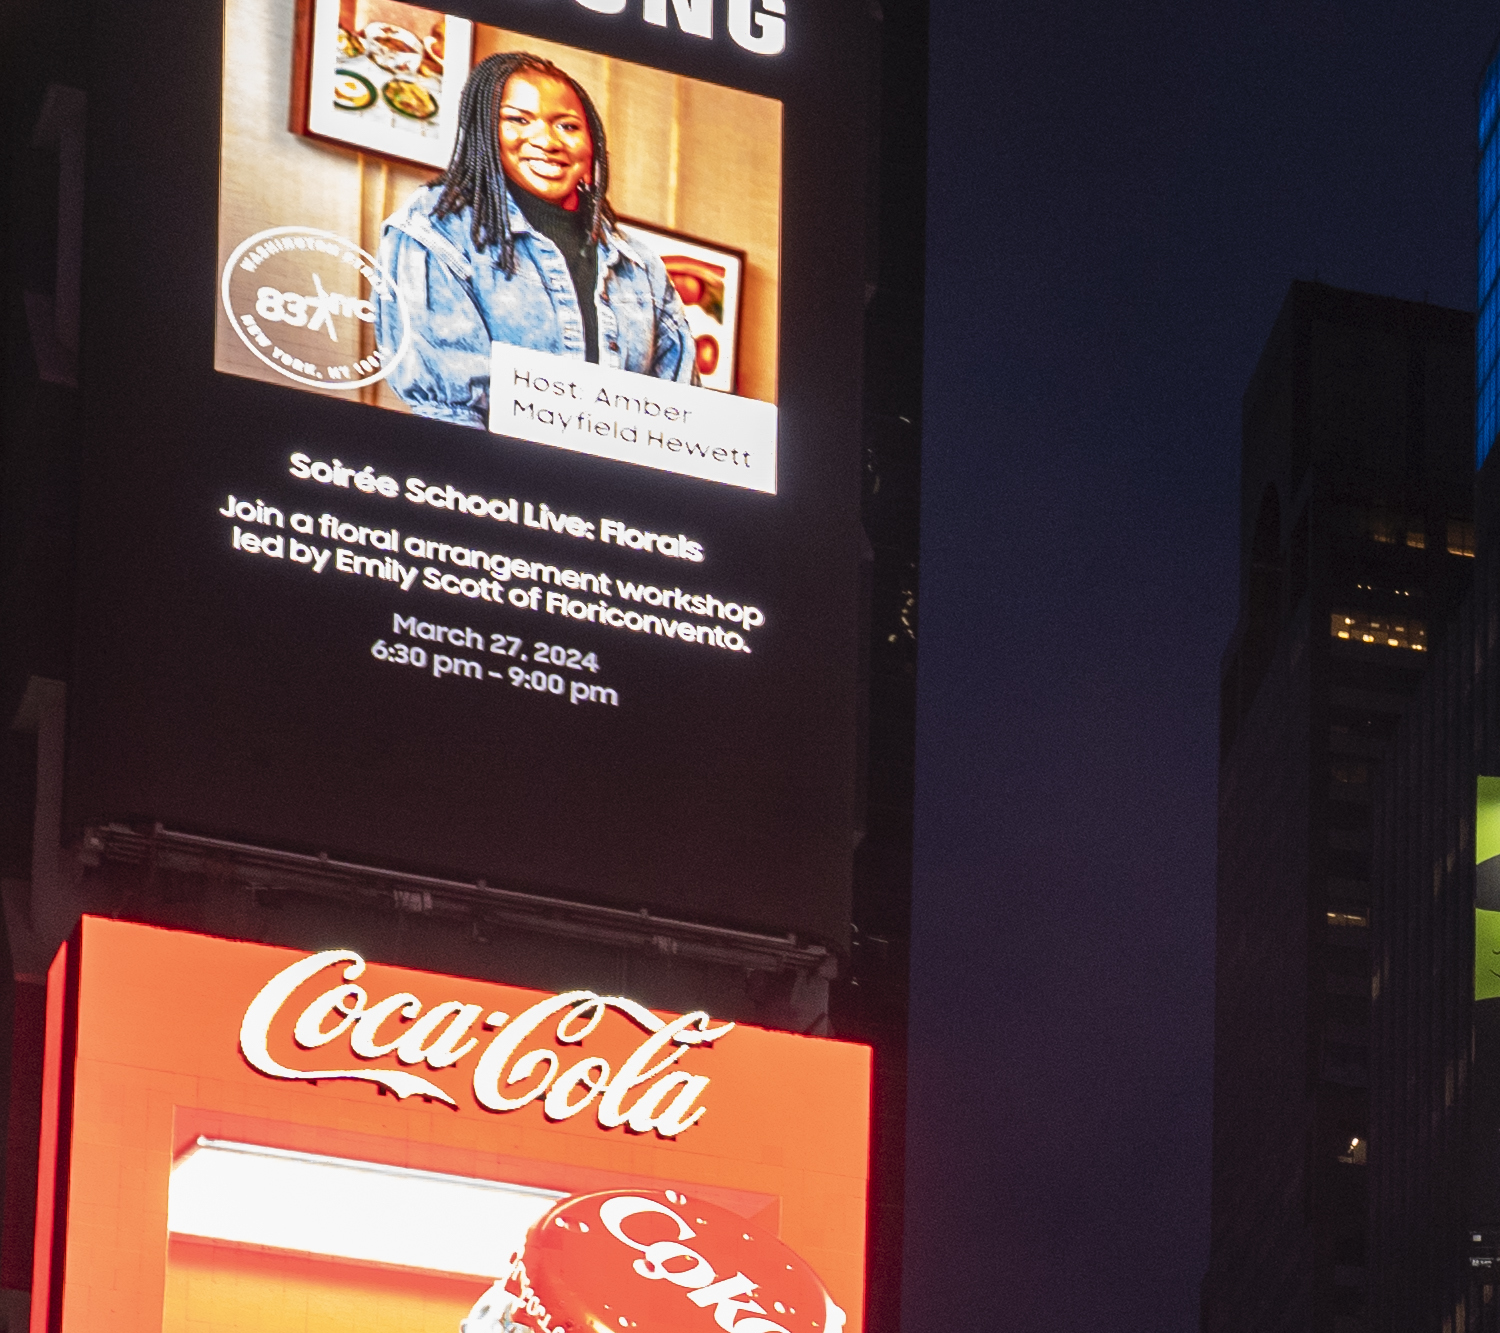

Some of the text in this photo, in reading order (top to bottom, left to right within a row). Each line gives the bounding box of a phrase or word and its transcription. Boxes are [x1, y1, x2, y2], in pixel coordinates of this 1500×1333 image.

[512, 367, 693, 425] Host: Amber
[512, 399, 753, 470] Mayfield Hewett
[289, 452, 705, 564] Soirée School Live: Florals
[219, 495, 765, 632] Join a floral arrangement workshop
[231, 525, 753, 654] led by Emily Scott of Floriconvento.
[370, 639, 620, 708] 6:30 pm 9:00 pm
[392, 612, 600, 675] March 27, 2024
